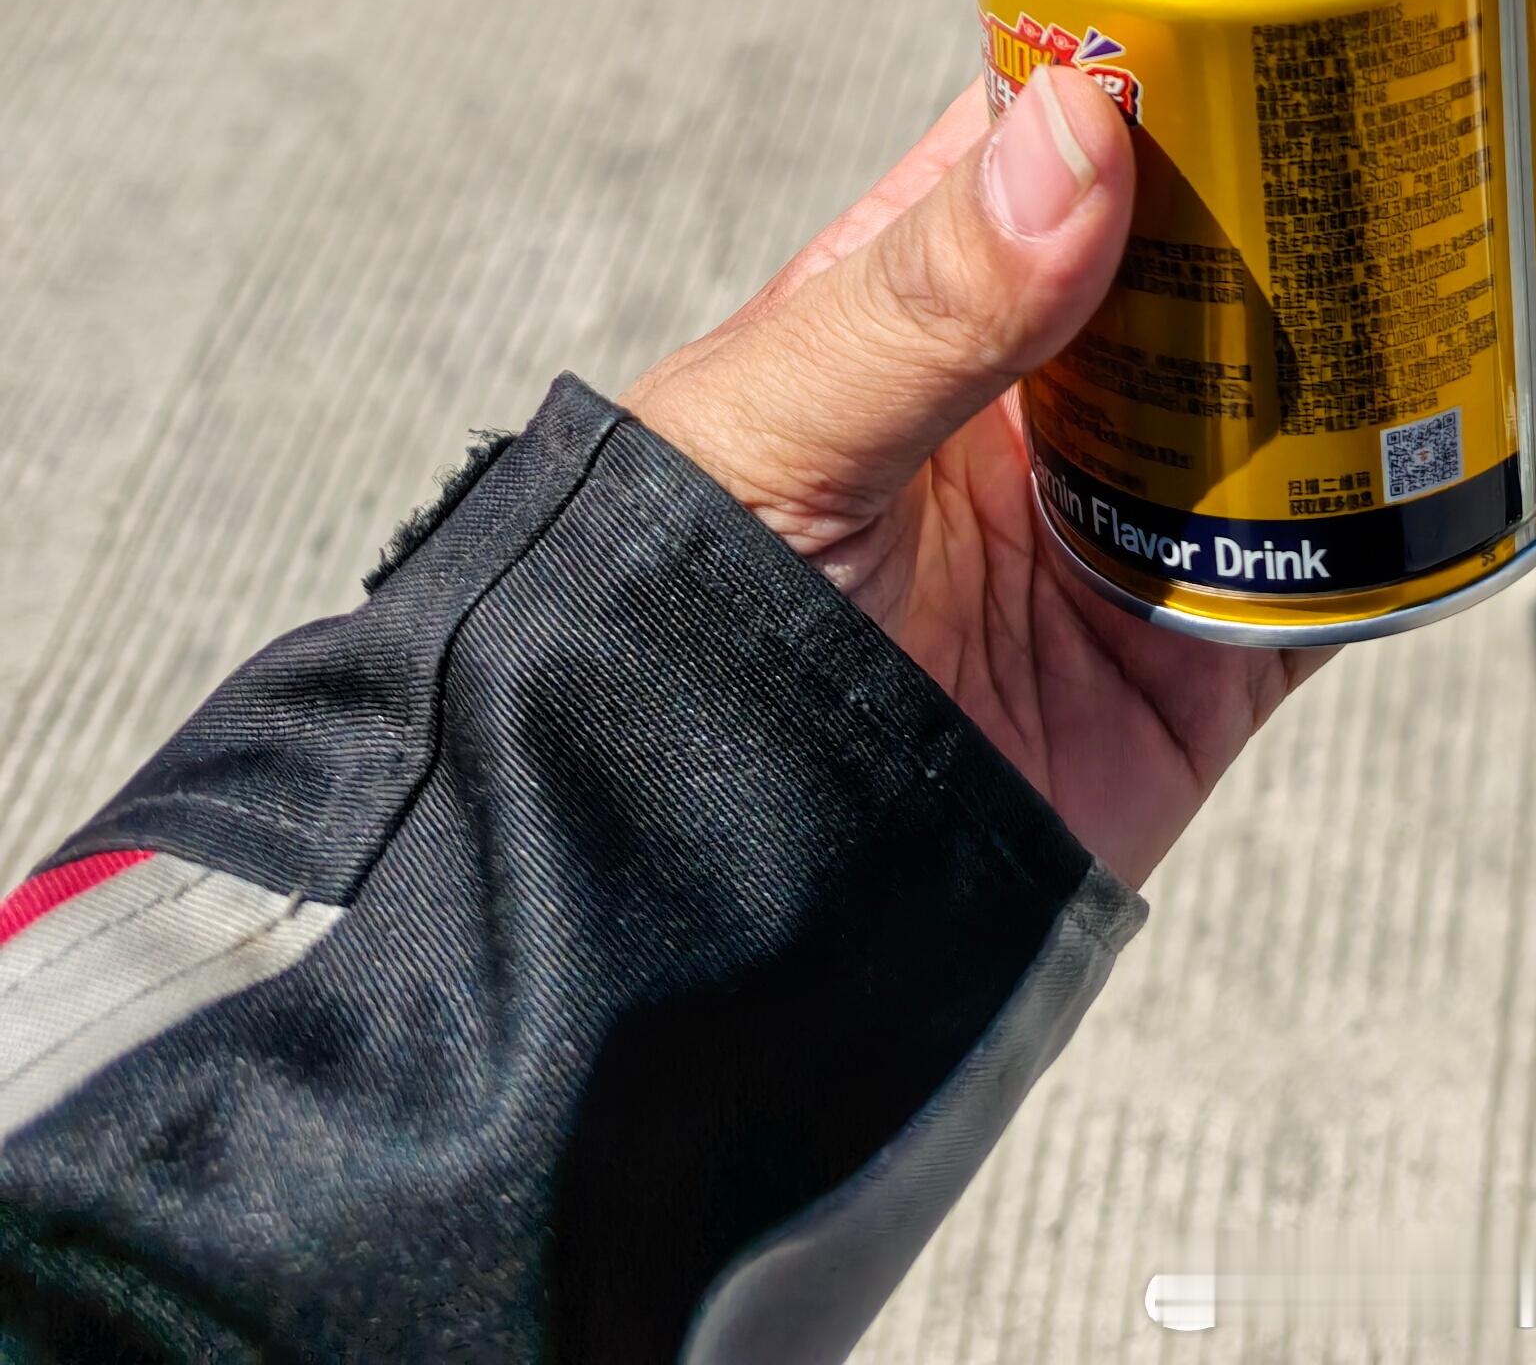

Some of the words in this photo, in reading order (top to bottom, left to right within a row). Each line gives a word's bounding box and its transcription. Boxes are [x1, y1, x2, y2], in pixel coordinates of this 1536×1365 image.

[1287, 469, 1372, 497] 扫描二维码
[1091, 495, 1203, 572] Flavor
[1213, 535, 1333, 582] Drink
